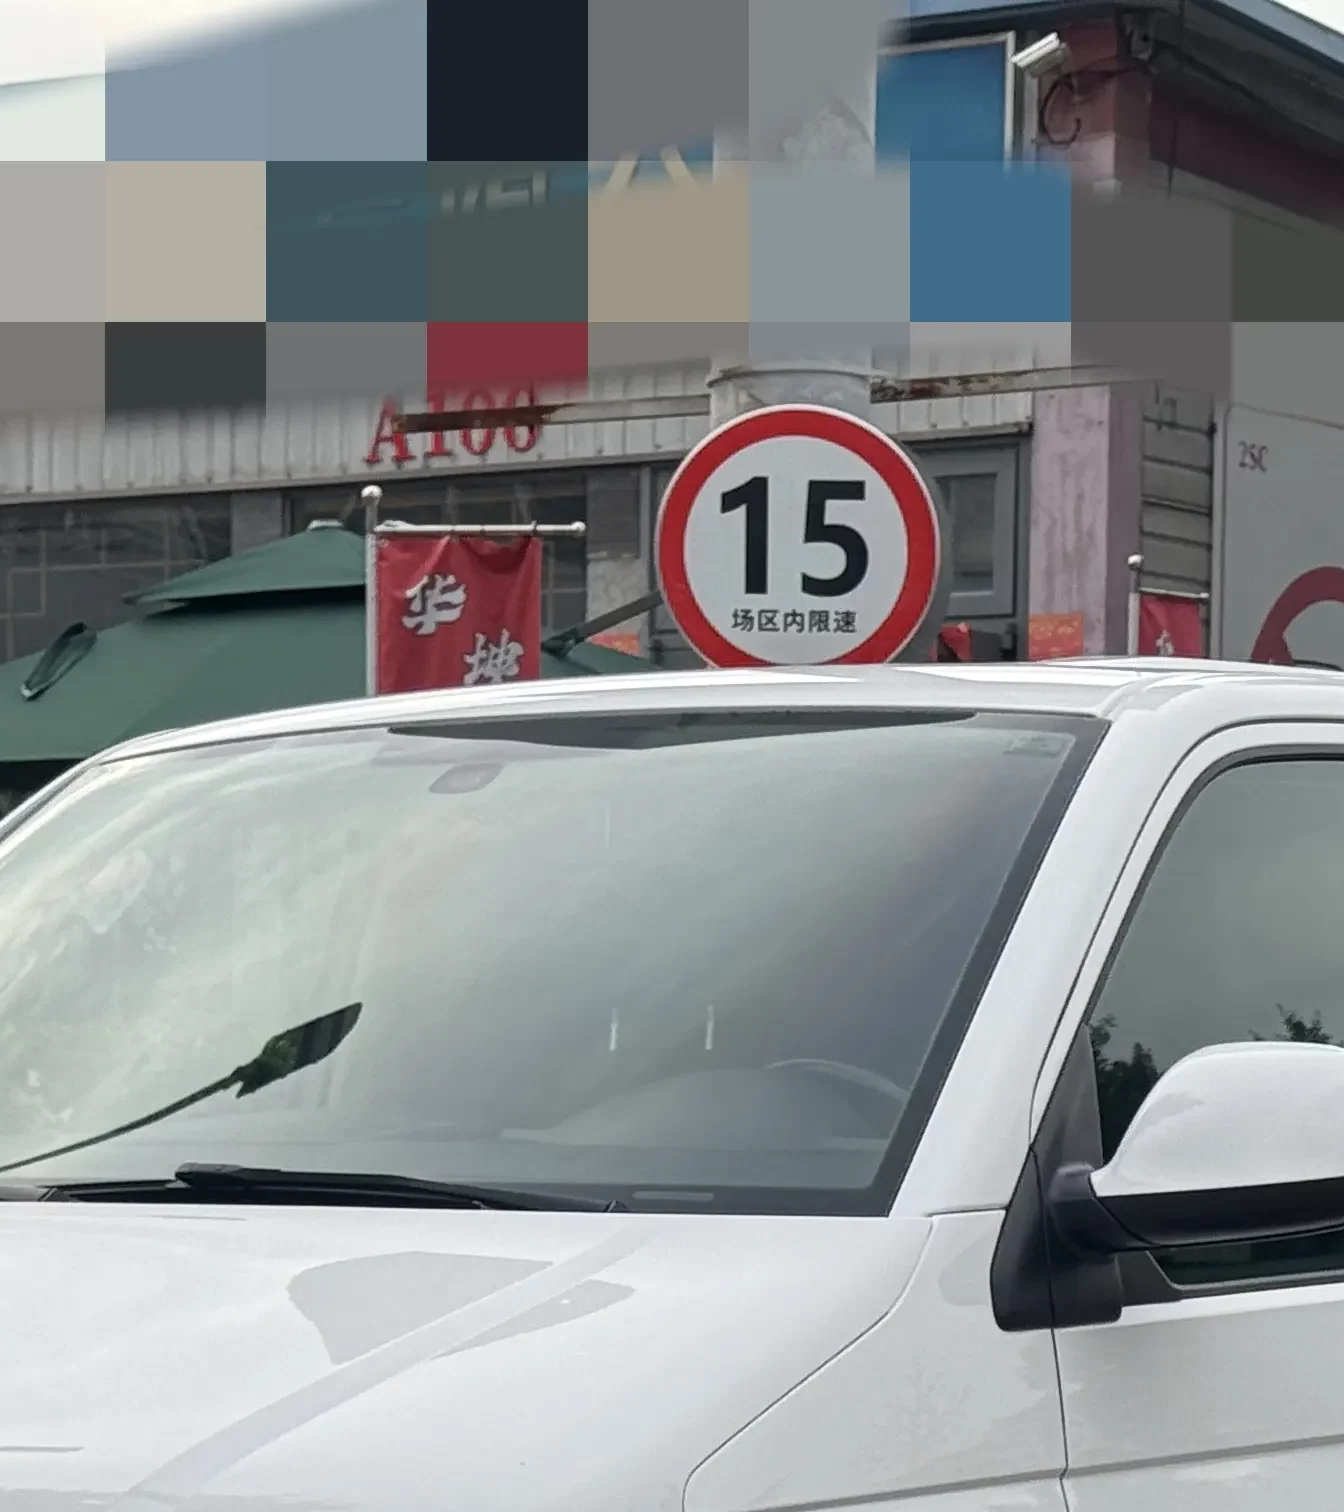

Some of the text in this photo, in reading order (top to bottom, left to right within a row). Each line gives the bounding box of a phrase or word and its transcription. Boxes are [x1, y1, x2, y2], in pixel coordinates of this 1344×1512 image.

[720, 475, 869, 597] 15
[731, 608, 858, 634] 场区内限速
